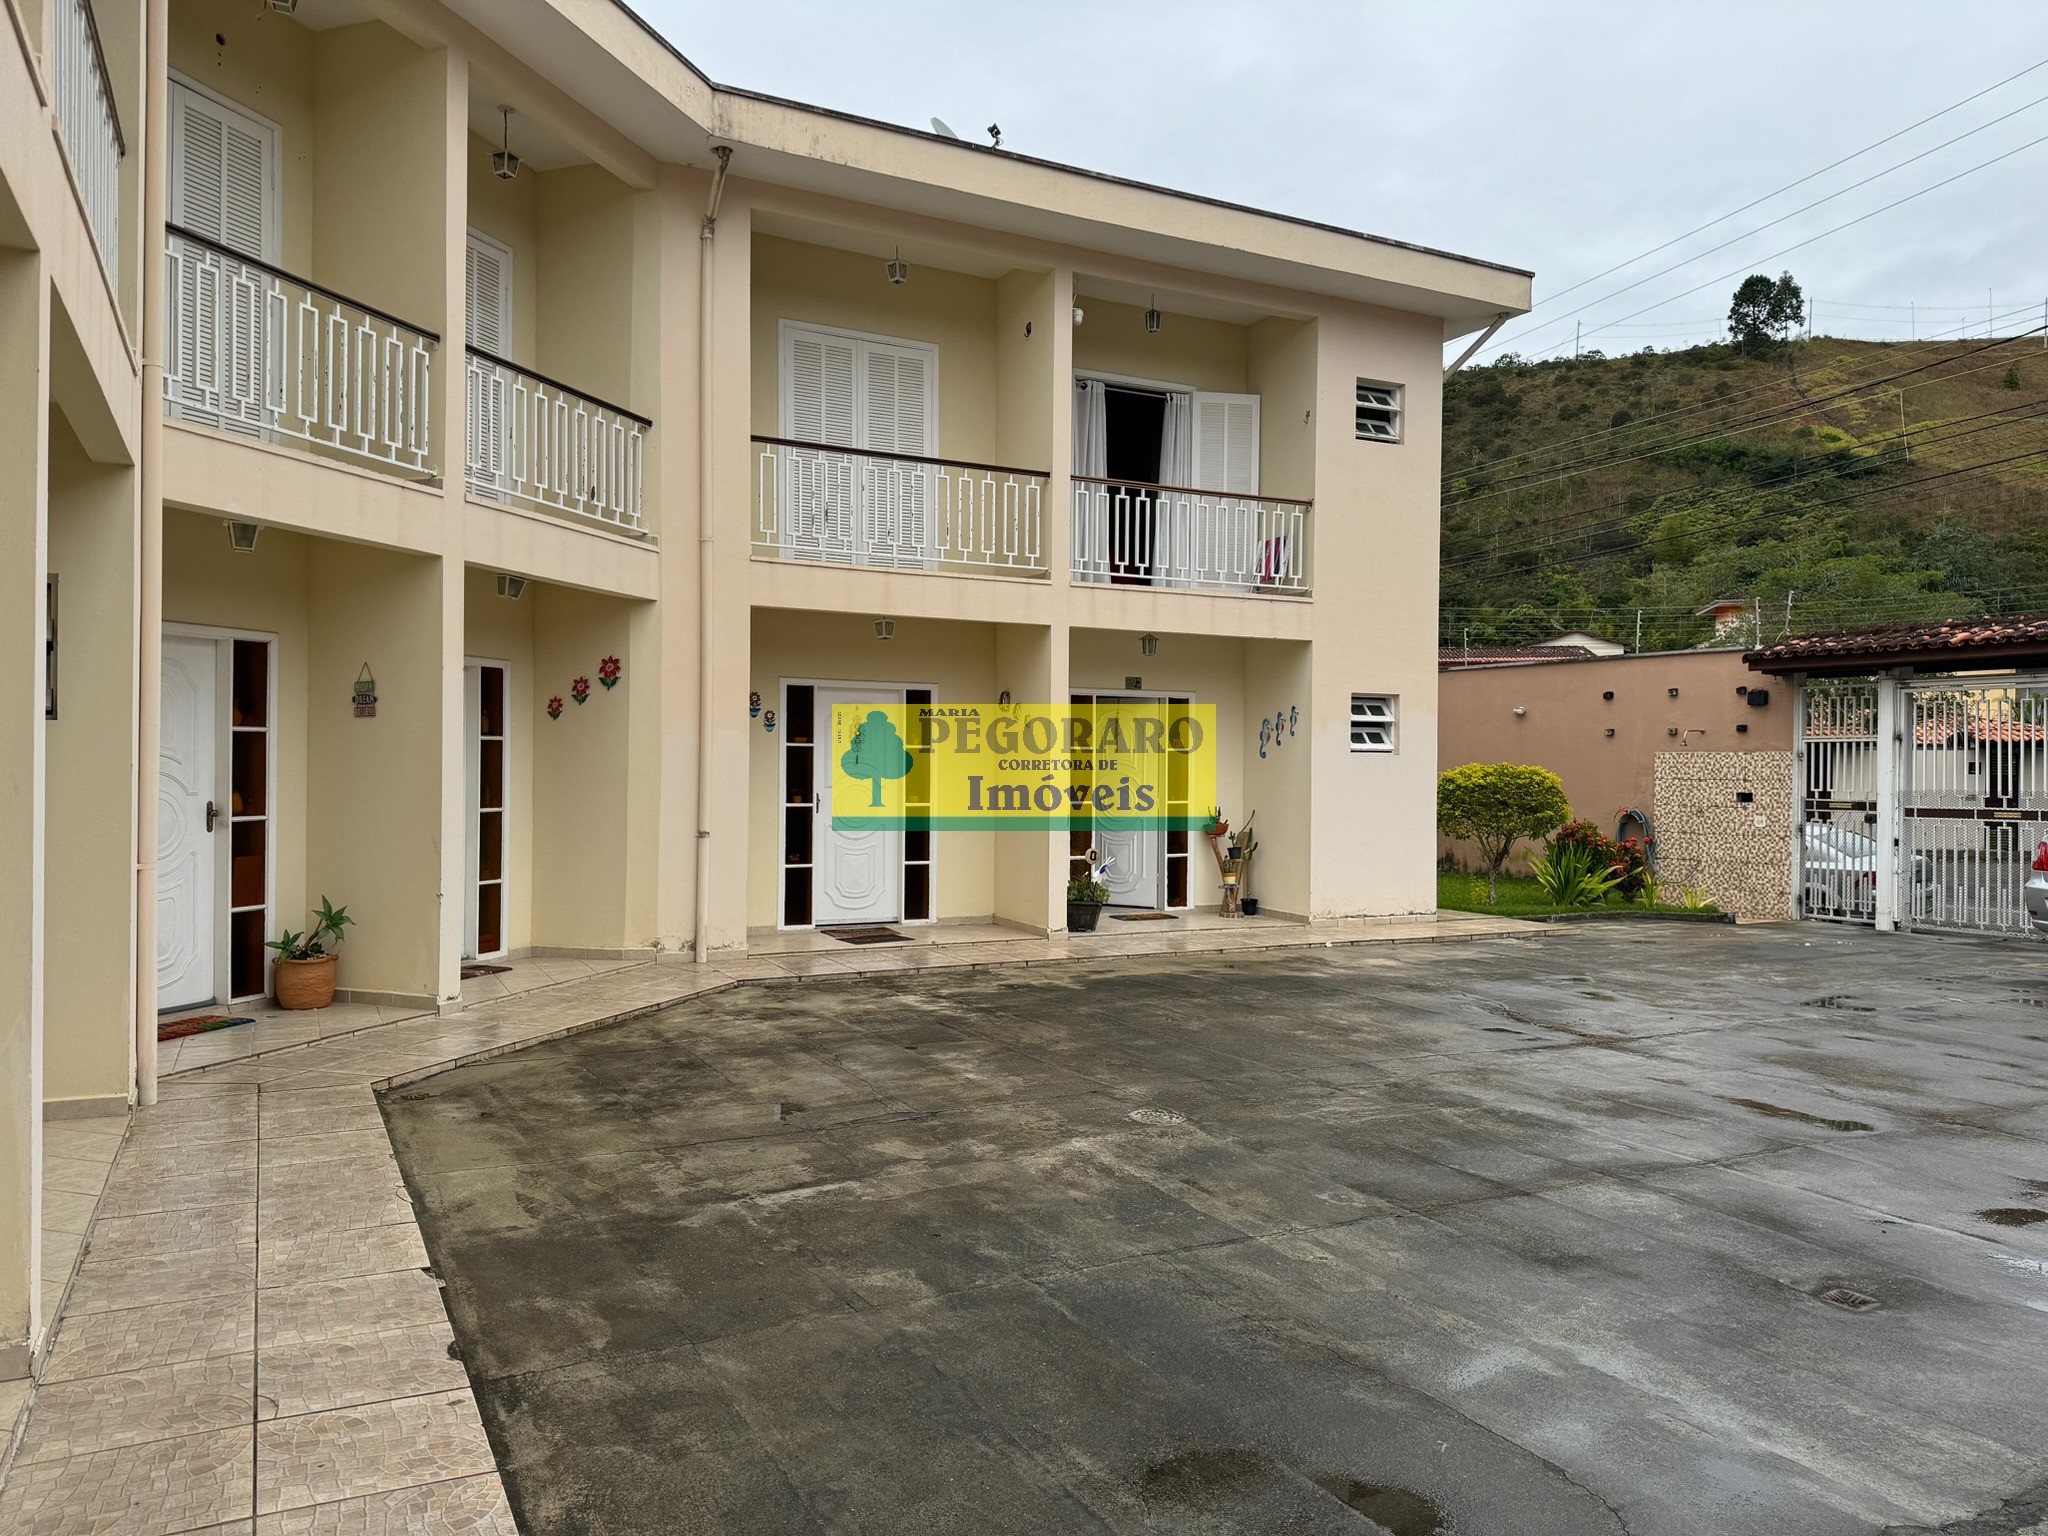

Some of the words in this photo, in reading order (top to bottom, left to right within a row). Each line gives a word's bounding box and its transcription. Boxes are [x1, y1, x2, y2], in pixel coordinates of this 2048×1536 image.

[355, 682, 374, 692] HOPE
[355, 695, 375, 704] DREAM
[354, 708, 376, 717] BELIEVE
